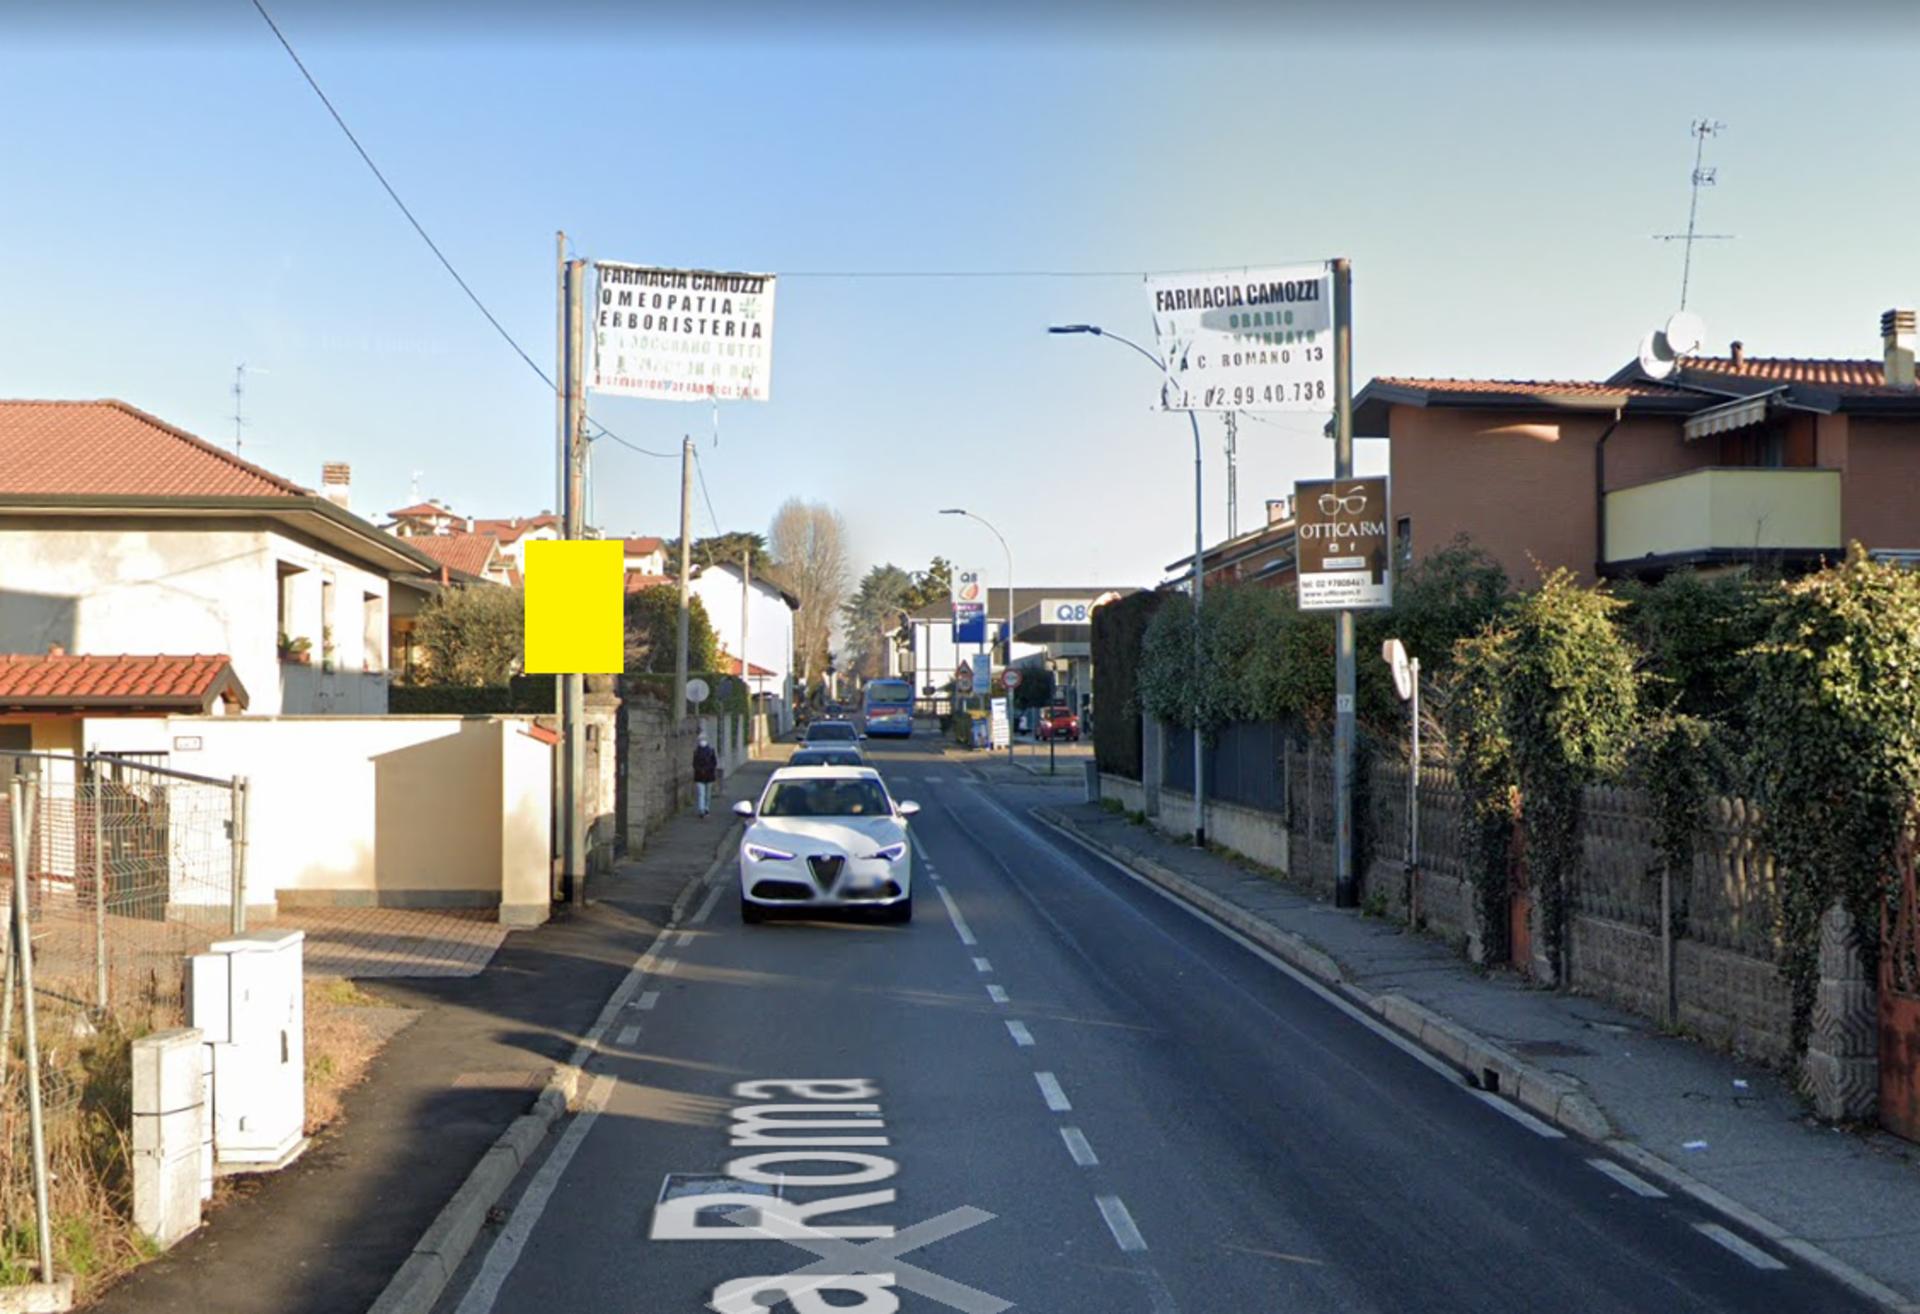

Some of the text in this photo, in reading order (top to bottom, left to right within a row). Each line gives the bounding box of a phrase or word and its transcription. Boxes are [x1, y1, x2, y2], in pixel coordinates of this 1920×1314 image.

[602, 267, 765, 294] FARMACIA CAMOZZI
[602, 289, 733, 315] OMEOPATIA
[1156, 279, 1319, 312] FARMACIA CAMOZZI
[599, 310, 763, 338] ERBORISTERIA
[1229, 310, 1294, 328] ORARIO
[1222, 349, 1291, 367] ROMANO
[1305, 347, 1324, 362] 13
[1204, 380, 1326, 407] 02.99.40.738
[1299, 521, 1386, 539] OTTICA RM
[960, 572, 977, 582] Q8
[1056, 604, 1087, 621] Q8
[1339, 697, 1351, 708] 17
